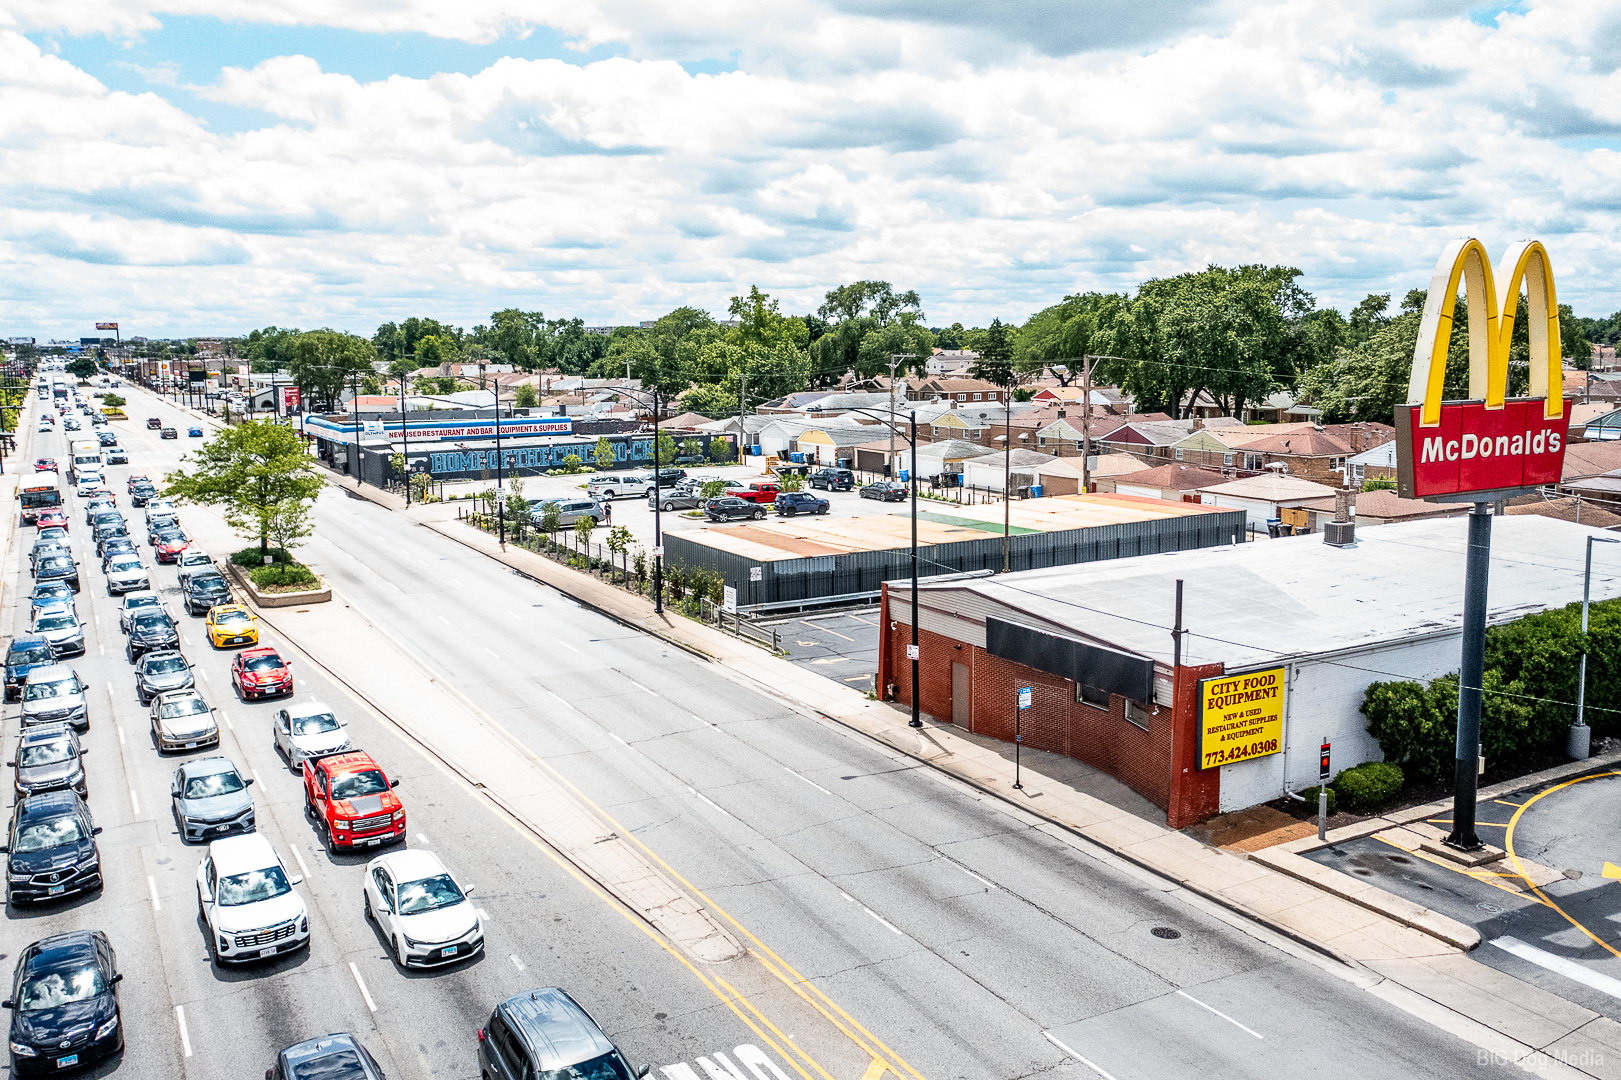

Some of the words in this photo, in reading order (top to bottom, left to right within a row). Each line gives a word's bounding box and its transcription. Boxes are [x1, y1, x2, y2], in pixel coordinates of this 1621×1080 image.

[422, 428, 465, 437] RESTAURANT
[466, 427, 480, 435] AND
[480, 427, 493, 435] BAR
[538, 423, 568, 432] SUPPLIES
[1421, 428, 1562, 463] McDonald's
[430, 451, 485, 473] HOME
[486, 449, 512, 470] OF
[511, 446, 550, 468] THE
[1211, 680, 1241, 696] CITY
[1242, 674, 1276, 690] FOOD
[1207, 686, 1279, 710] EQUIPMENT
[1207, 720, 1248, 735] RESTAURANT
[1248, 714, 1278, 726] SUPPLIES
[1223, 712, 1239, 721] NEW
[1245, 708, 1262, 717] USED
[1226, 726, 1264, 740] EQUIPMENT
[1204, 738, 1278, 766] 773.424.0308
